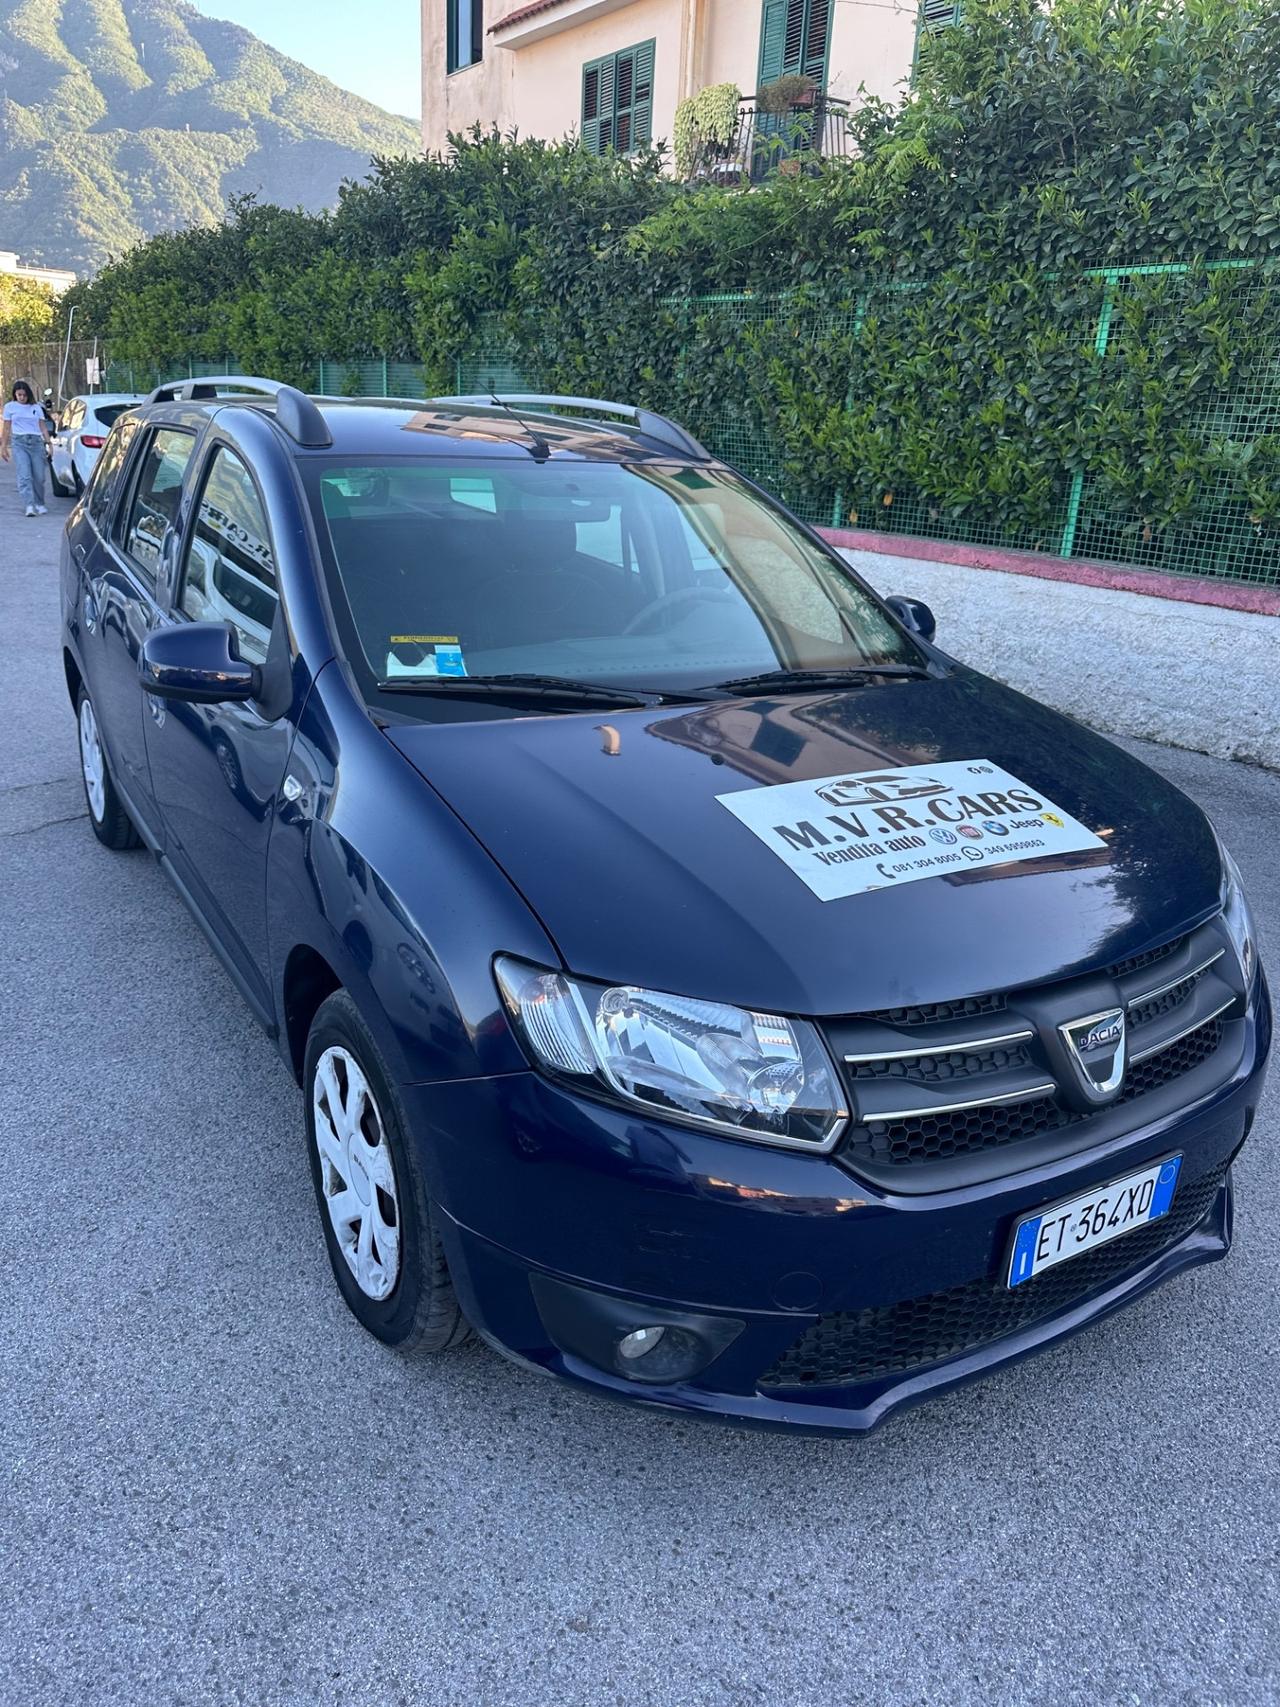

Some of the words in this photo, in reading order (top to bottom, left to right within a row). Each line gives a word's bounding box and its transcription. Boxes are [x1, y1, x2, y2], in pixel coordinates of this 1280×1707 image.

[772, 789, 1043, 851] M.V.R.CARS
[1009, 818, 1045, 829] Jeep
[812, 841, 887, 866] Vendita
[884, 834, 926, 852] auto
[892, 862, 914, 873] 081
[913, 858, 936, 869] 304
[934, 853, 962, 865] 8005
[984, 845, 1005, 855] 349
[1079, 1025, 1120, 1046] DACIA
